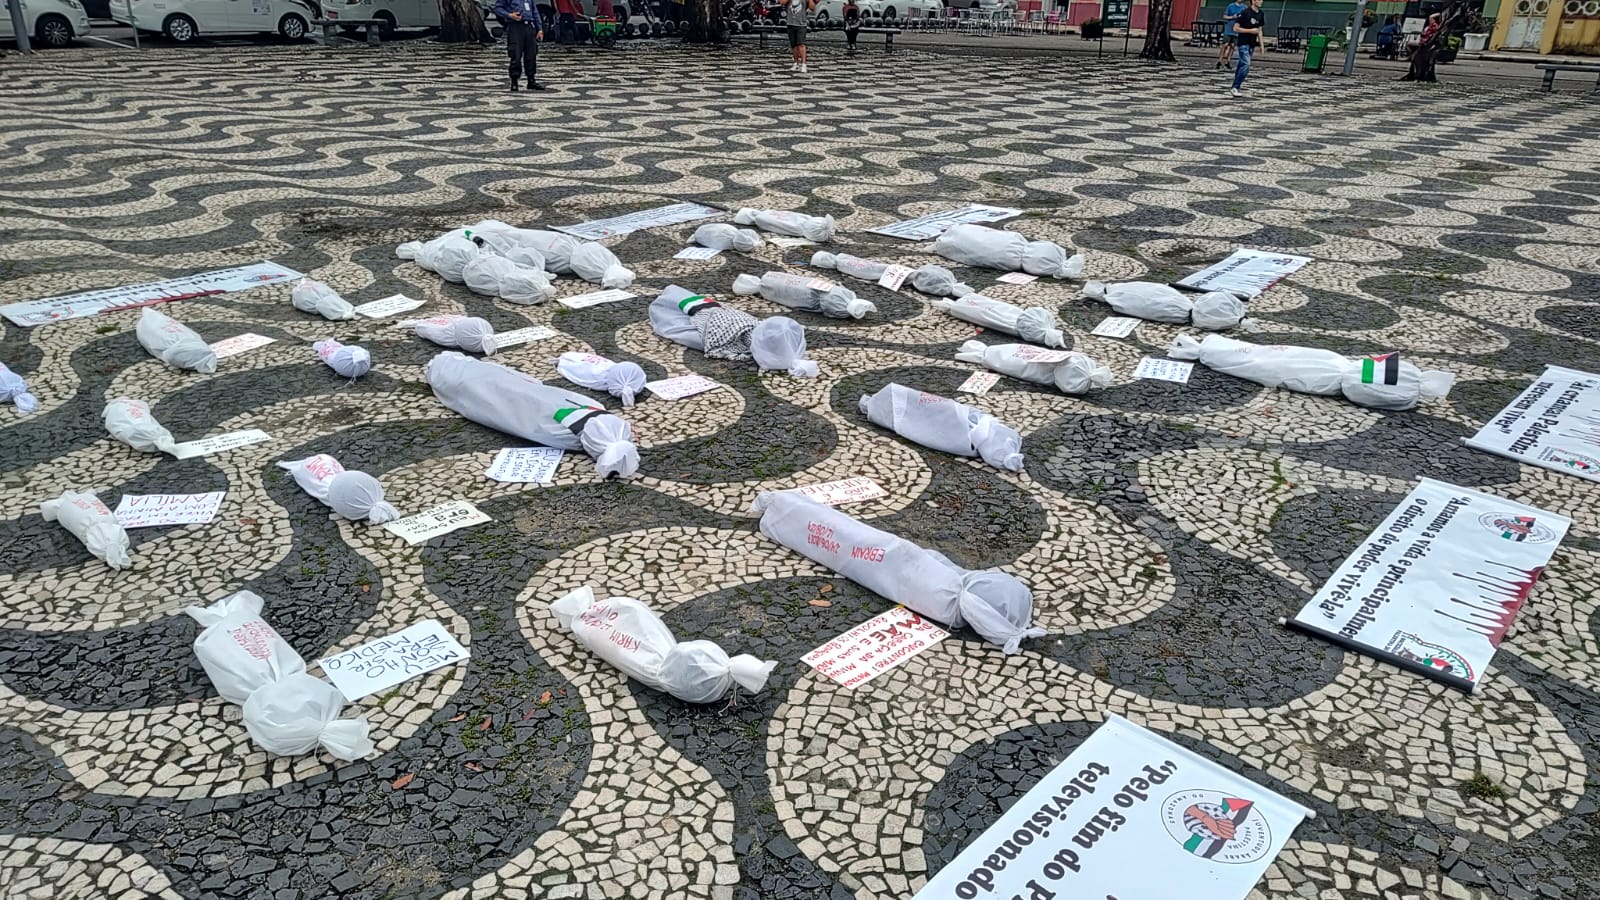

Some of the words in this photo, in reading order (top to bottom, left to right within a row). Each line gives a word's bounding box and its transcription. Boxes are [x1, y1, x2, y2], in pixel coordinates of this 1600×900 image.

[1415, 498, 1428, 506] o
[1388, 506, 1426, 534] direito
[1428, 497, 1473, 533] “Amamos
[1378, 532, 1400, 546] de
[1421, 531, 1435, 539] a
[1352, 542, 1387, 573] poder
[1403, 539, 1431, 559] vida
[1398, 559, 1413, 567] e
[1318, 573, 1362, 620] vivê-la”
[890, 607, 908, 617] EU
[869, 613, 922, 642] MÃE
[915, 623, 933, 632] DA
[929, 629, 947, 640] EU
[395, 634, 439, 658] ERA
[609, 630, 640, 653] KARIM
[837, 644, 861, 660] SUAS
[859, 638, 872, 646] E
[875, 632, 914, 654] CABEÇA
[355, 654, 386, 672] SER
[366, 640, 448, 678] SONHO
[858, 652, 875, 662] DA
[1114, 759, 1178, 808] “Pelo
[955, 760, 1110, 900] televisionado
[1071, 806, 1128, 850] fim
[1042, 850, 1081, 881] do
